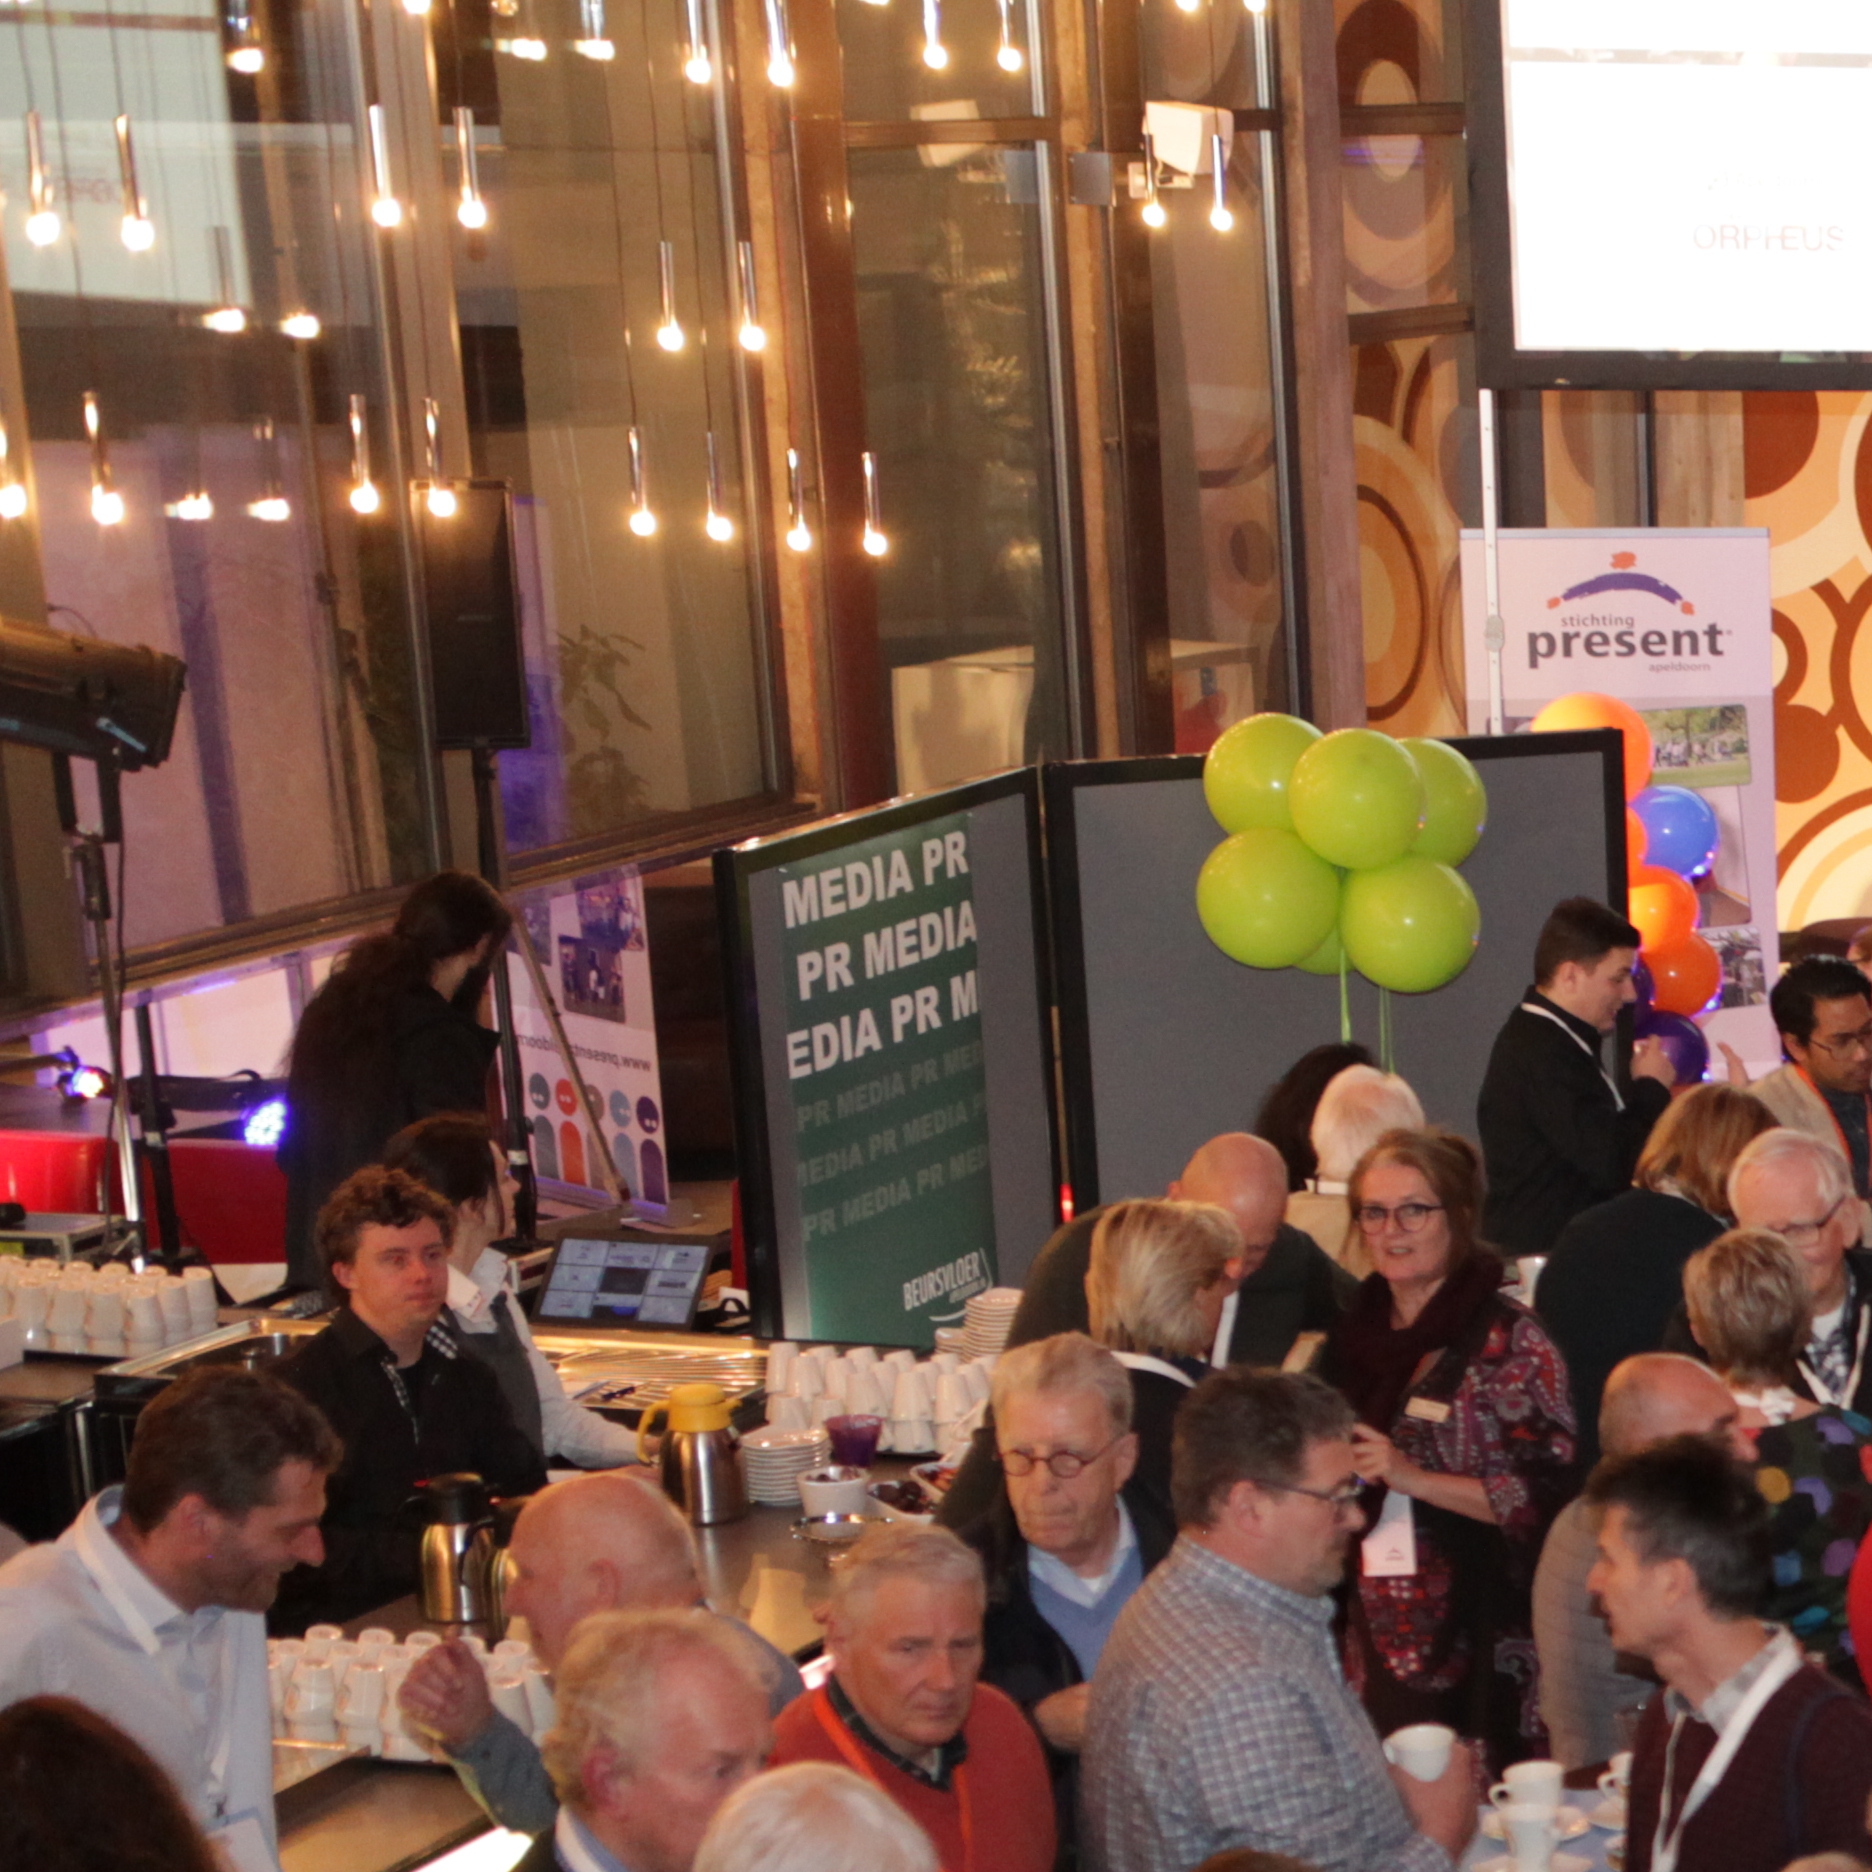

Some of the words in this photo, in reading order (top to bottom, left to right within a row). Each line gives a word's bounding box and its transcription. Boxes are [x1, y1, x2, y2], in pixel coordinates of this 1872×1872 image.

[1692, 223, 1845, 252] ORPHEUS
[1527, 622, 1725, 670] present
[1561, 614, 1635, 629] stichting
[1648, 661, 1712, 673] apeldoorn
[782, 849, 914, 929] MEDIA
[922, 831, 969, 886] PR
[797, 942, 855, 1001] PR
[863, 900, 978, 980] MEDIA
[890, 986, 943, 1043] PR
[798, 1099, 831, 1132] PR
[837, 1071, 906, 1119] MEDIA
[911, 1058, 939, 1090] PR
[869, 1128, 899, 1161] PR
[903, 1100, 968, 1146] MEDIA
[801, 1208, 837, 1242] PR
[843, 1176, 912, 1226] MEDIA
[917, 1163, 945, 1195] PR
[903, 1251, 981, 1311] BEURSVLOER
